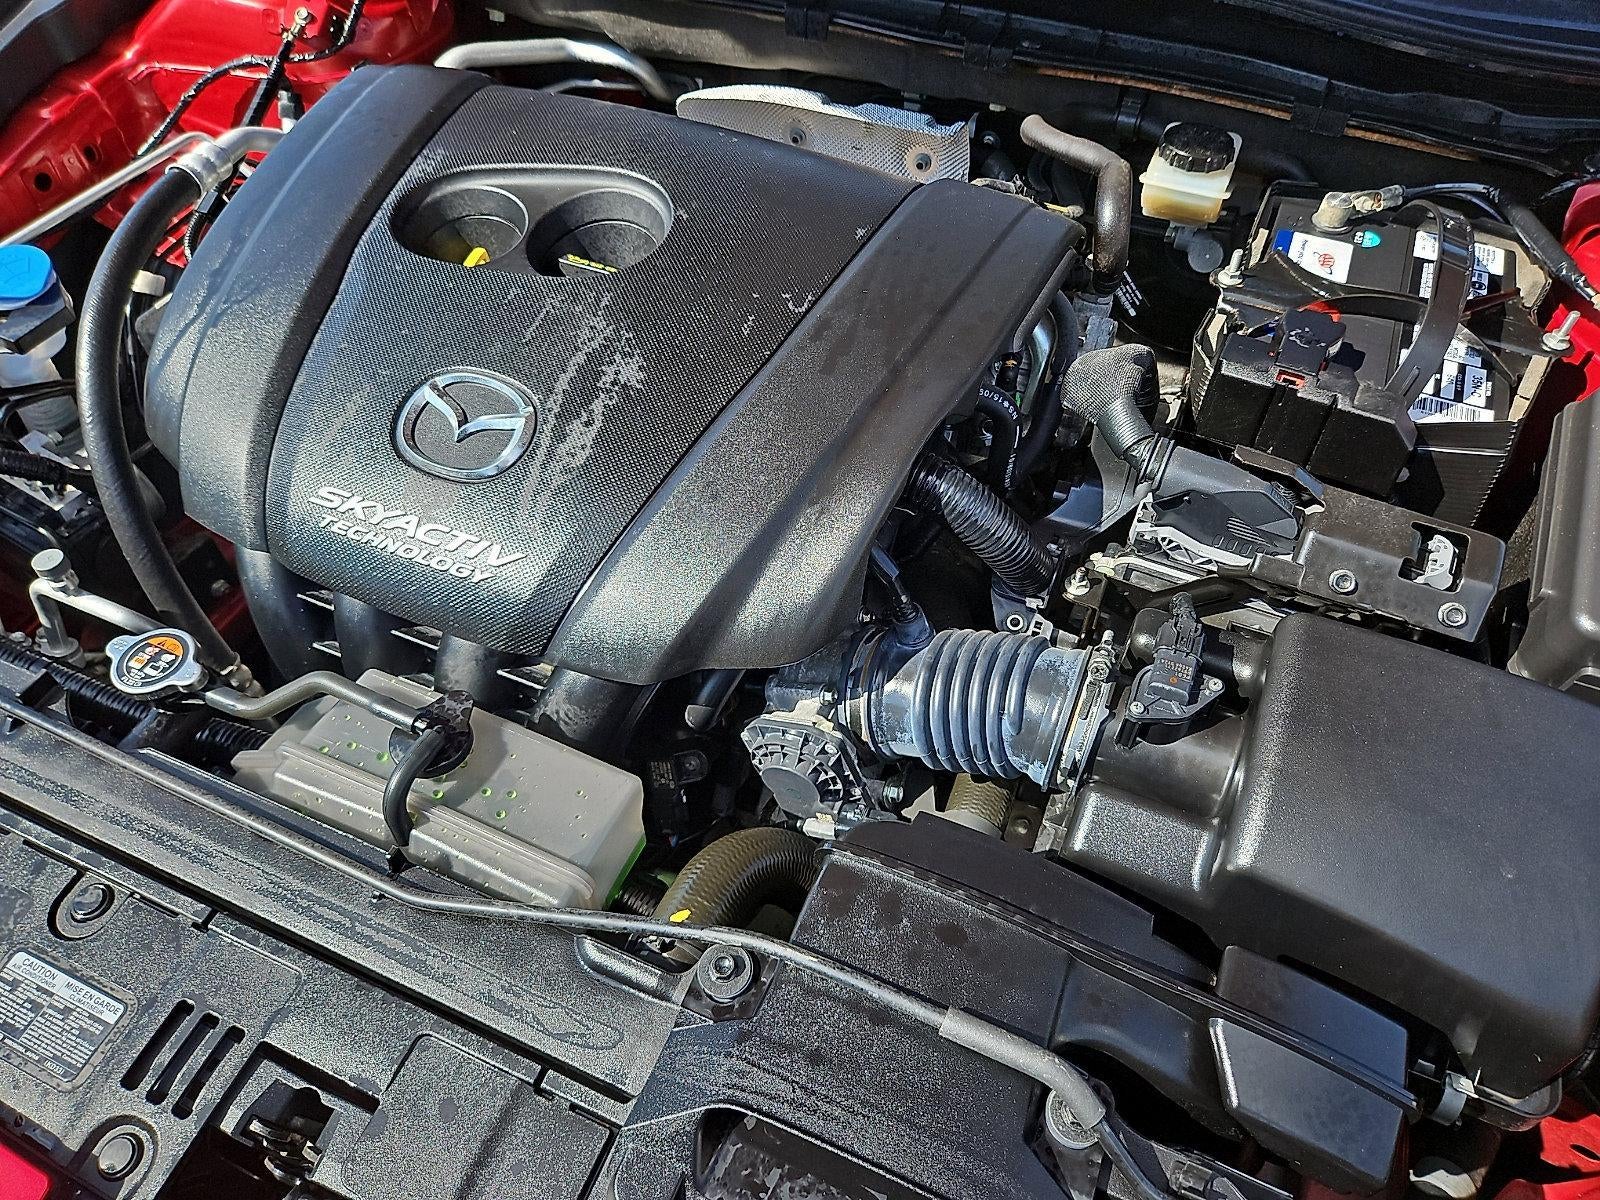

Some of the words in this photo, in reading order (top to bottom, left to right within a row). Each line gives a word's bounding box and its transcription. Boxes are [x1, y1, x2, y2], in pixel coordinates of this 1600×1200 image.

[308, 486, 528, 567] SKYACTIV
[320, 514, 496, 584] TECHNOLOGY
[22, 957, 59, 981] CAUTION
[22, 967, 56, 989] CONDITIONER
[65, 981, 84, 995] MISE
[82, 990, 95, 1001] EN
[94, 997, 121, 1015] GARDE
[69, 994, 104, 1016] CLIMATISEUR
